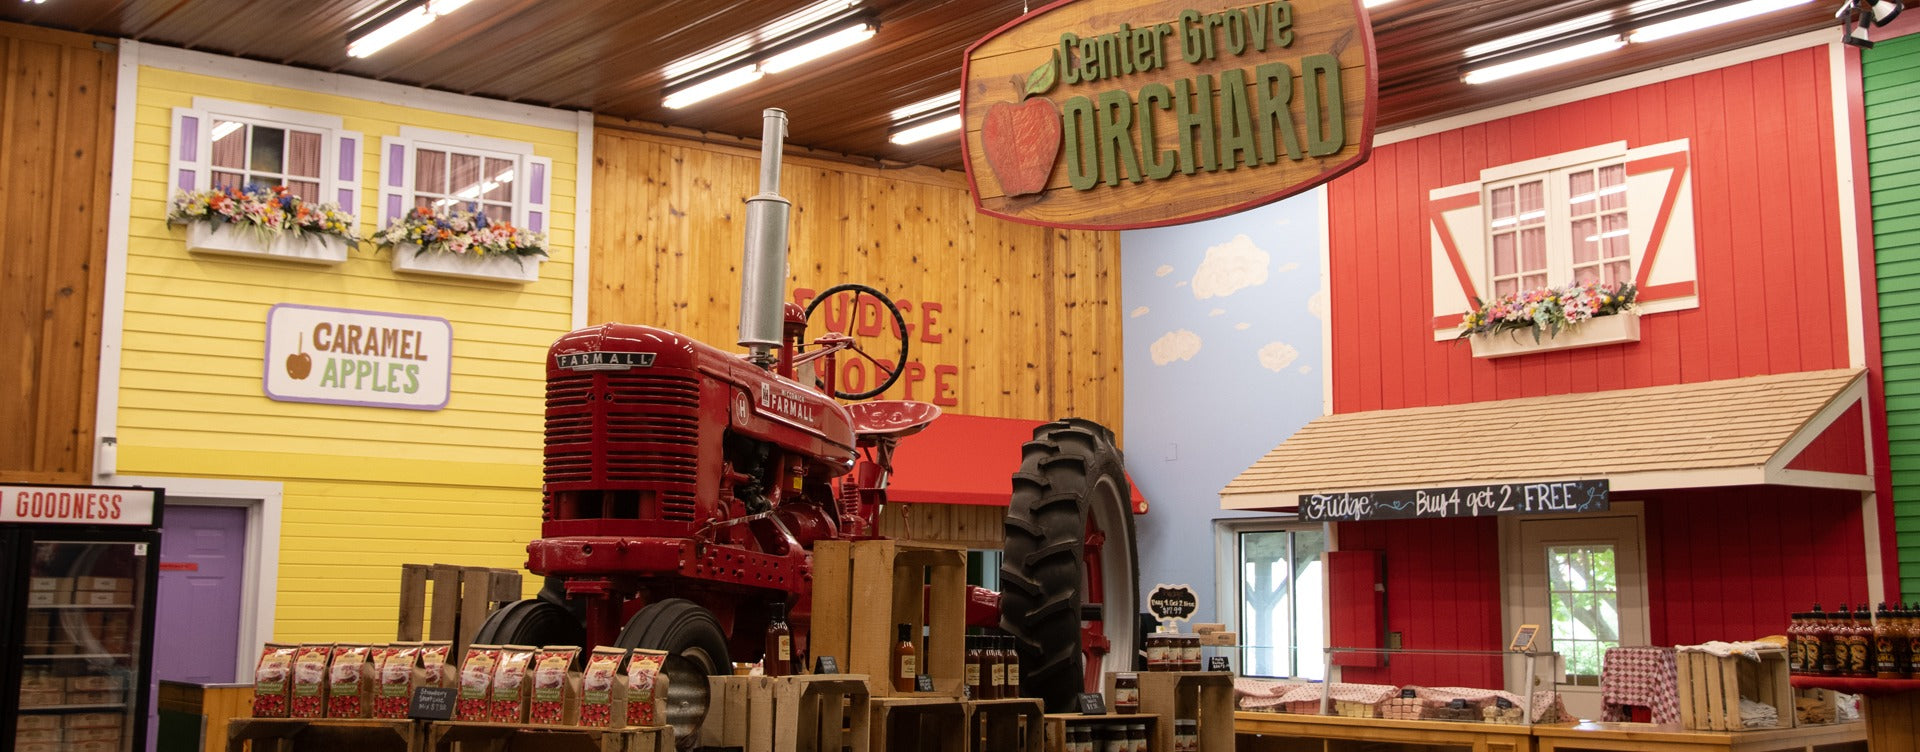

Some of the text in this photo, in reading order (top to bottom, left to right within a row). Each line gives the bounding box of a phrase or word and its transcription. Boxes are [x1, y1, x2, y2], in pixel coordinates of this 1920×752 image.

[1059, 1, 1294, 85] Center Grove
[1063, 52, 1346, 191] ORCHARD
[313, 322, 428, 361] CARAMEL
[561, 353, 648, 367] FARMALL
[320, 357, 420, 394] APPLES
[739, 399, 746, 418] H
[771, 394, 814, 422] FARMALL
[16, 491, 122, 520] GOODNESS
[1307, 482, 1577, 521] Fudge Buy 4 get 2 FREE
